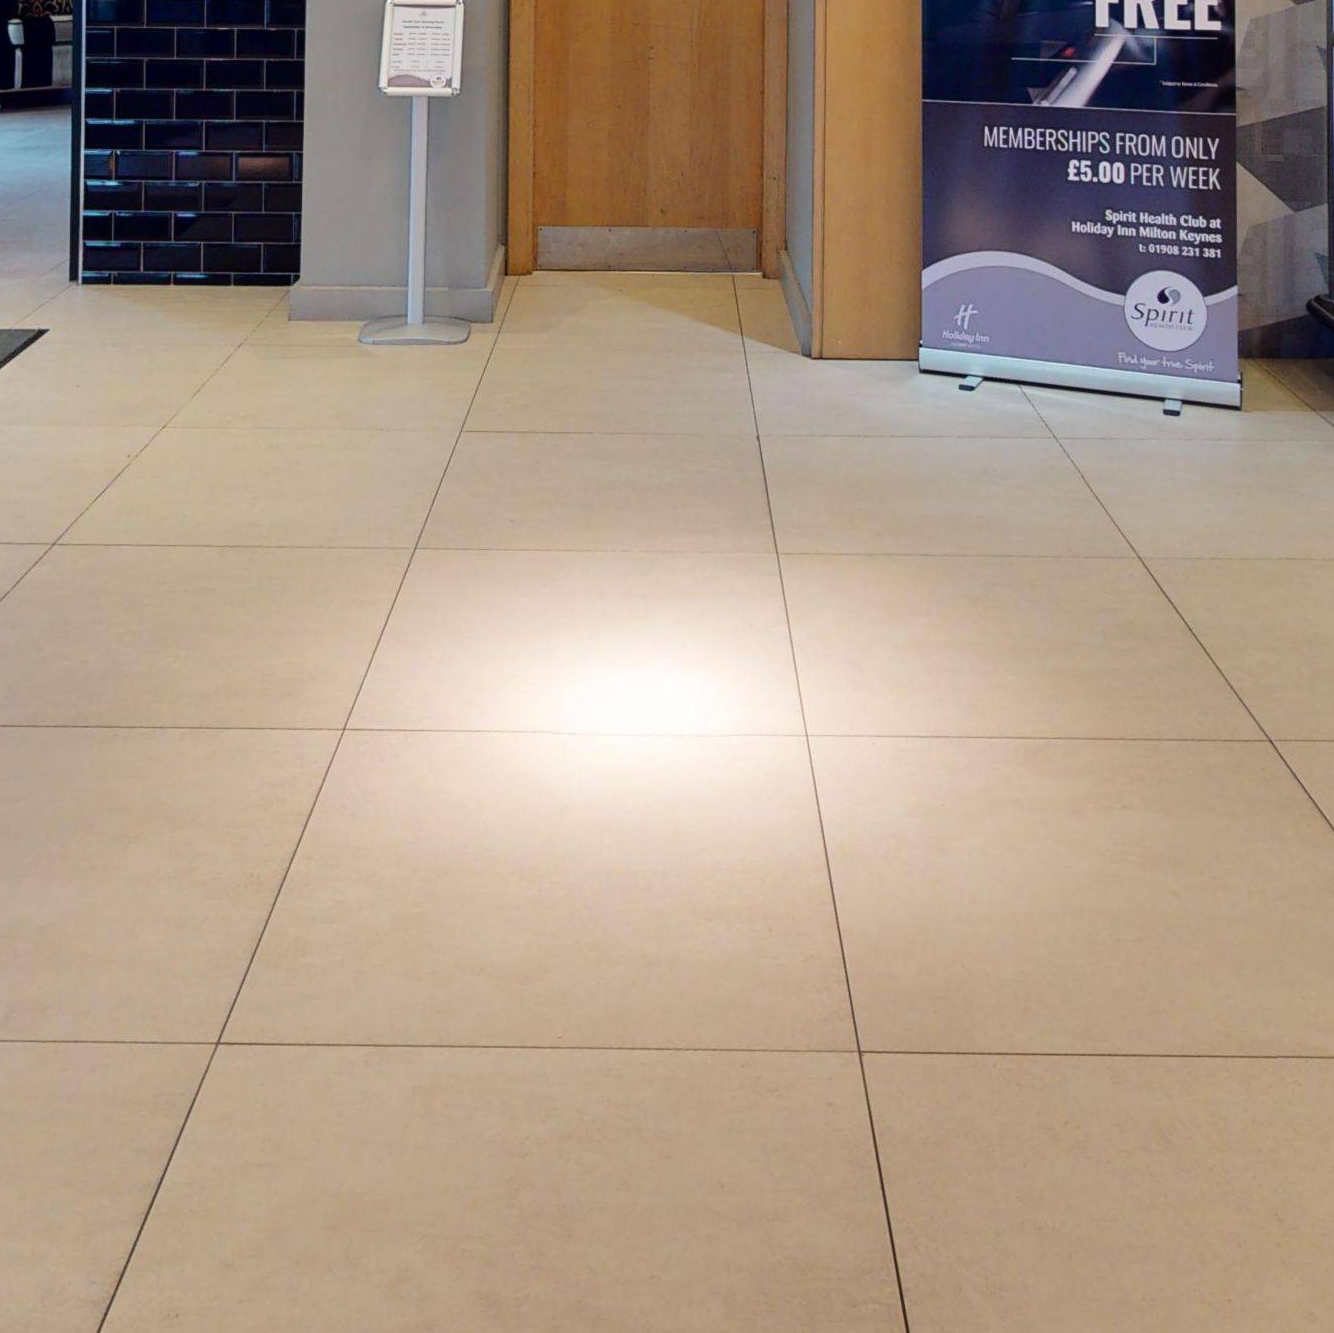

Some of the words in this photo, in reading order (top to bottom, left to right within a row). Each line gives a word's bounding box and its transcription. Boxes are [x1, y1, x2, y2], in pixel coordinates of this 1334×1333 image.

[983, 125, 1111, 155] MEMBERSHIPS
[1115, 133, 1167, 158] FROM
[1171, 135, 1220, 160] ONLY
[1067, 159, 1125, 184] £5.00
[1130, 163, 1165, 187] PER
[1169, 165, 1221, 191] WEEK
[1104, 209, 1137, 224] Spirit
[1139, 212, 1177, 226] Health
[1179, 215, 1207, 229] Club
[1209, 218, 1222, 229] at
[1071, 221, 1115, 238] Holiday
[1117, 224, 1136, 237] Inn
[1139, 226, 1177, 240] Milton
[1179, 229, 1223, 245] Keynes
[1148, 244, 1180, 256] 01908
[1181, 246, 1200, 257] 231
[1202, 248, 1222, 259] 381
[1130, 302, 1195, 327] Spirit
[941, 329, 974, 344] Holiday
[975, 332, 990, 344] Inn
